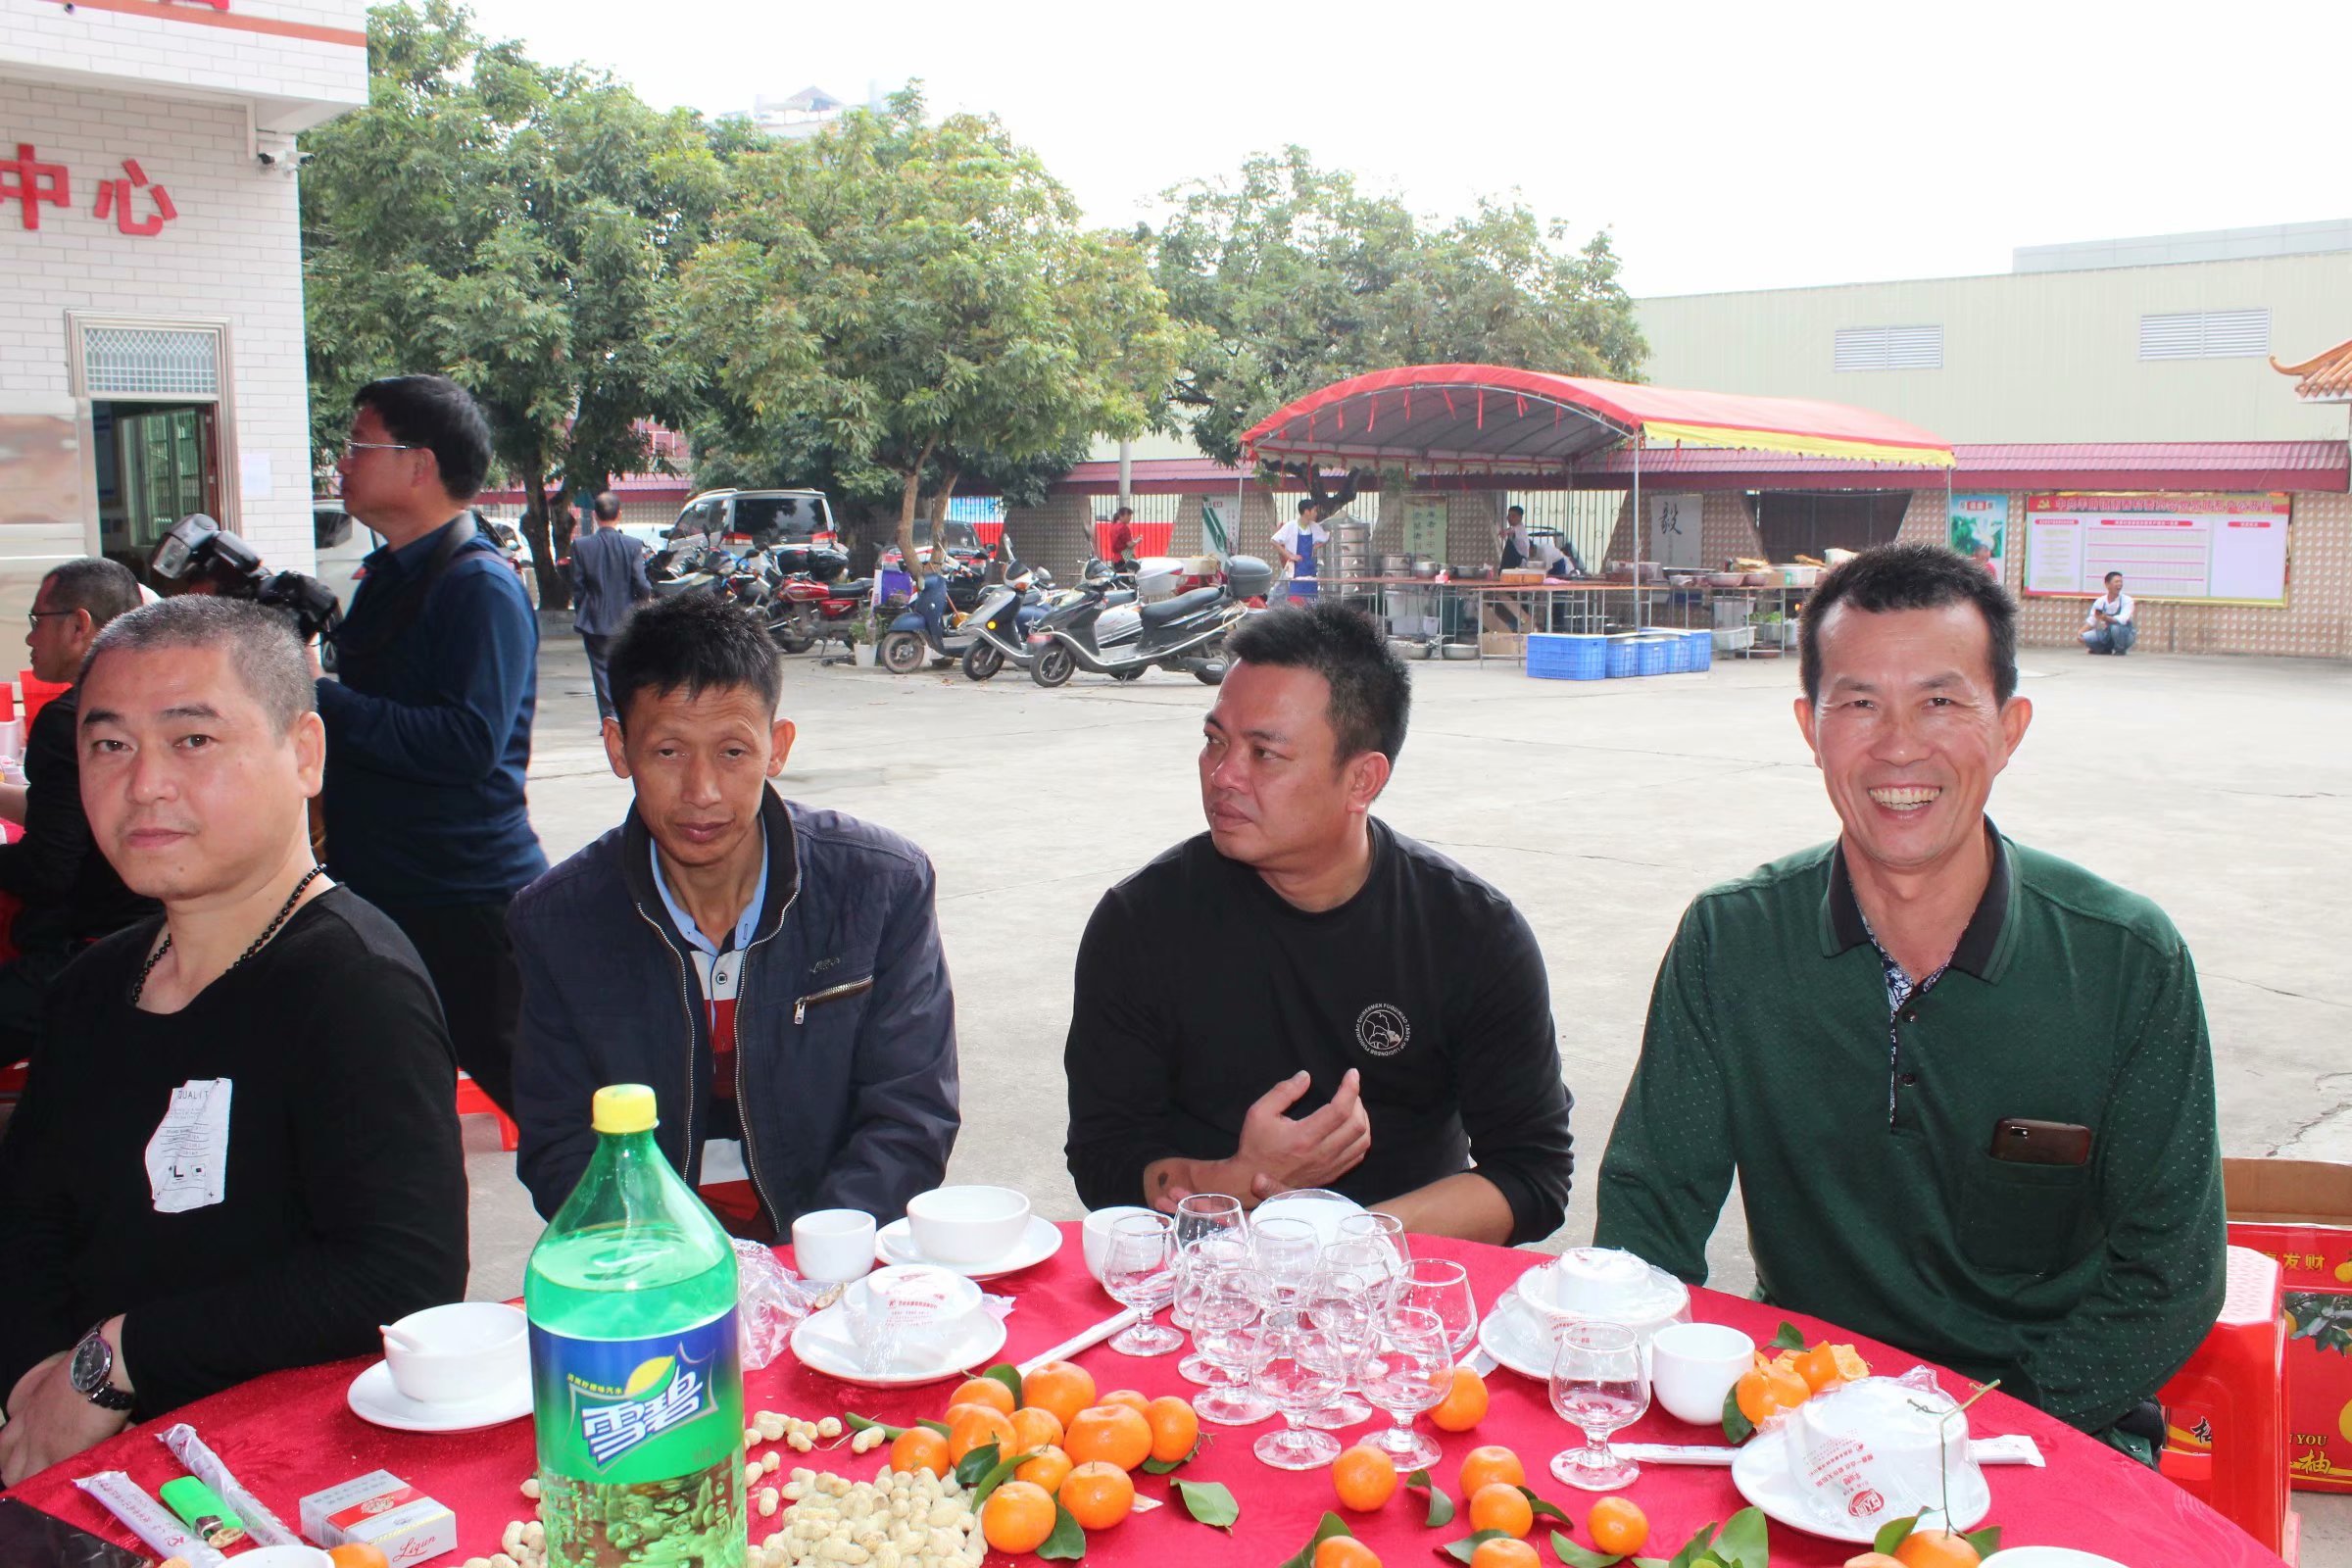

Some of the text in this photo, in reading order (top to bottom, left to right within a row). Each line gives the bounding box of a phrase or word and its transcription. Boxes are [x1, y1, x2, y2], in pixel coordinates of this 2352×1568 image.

[0, 143, 178, 236] 中心
[582, 1364, 703, 1464] 雪碧
[2296, 1434, 2328, 1446] YOU
[392, 1536, 438, 1562] Liqun
